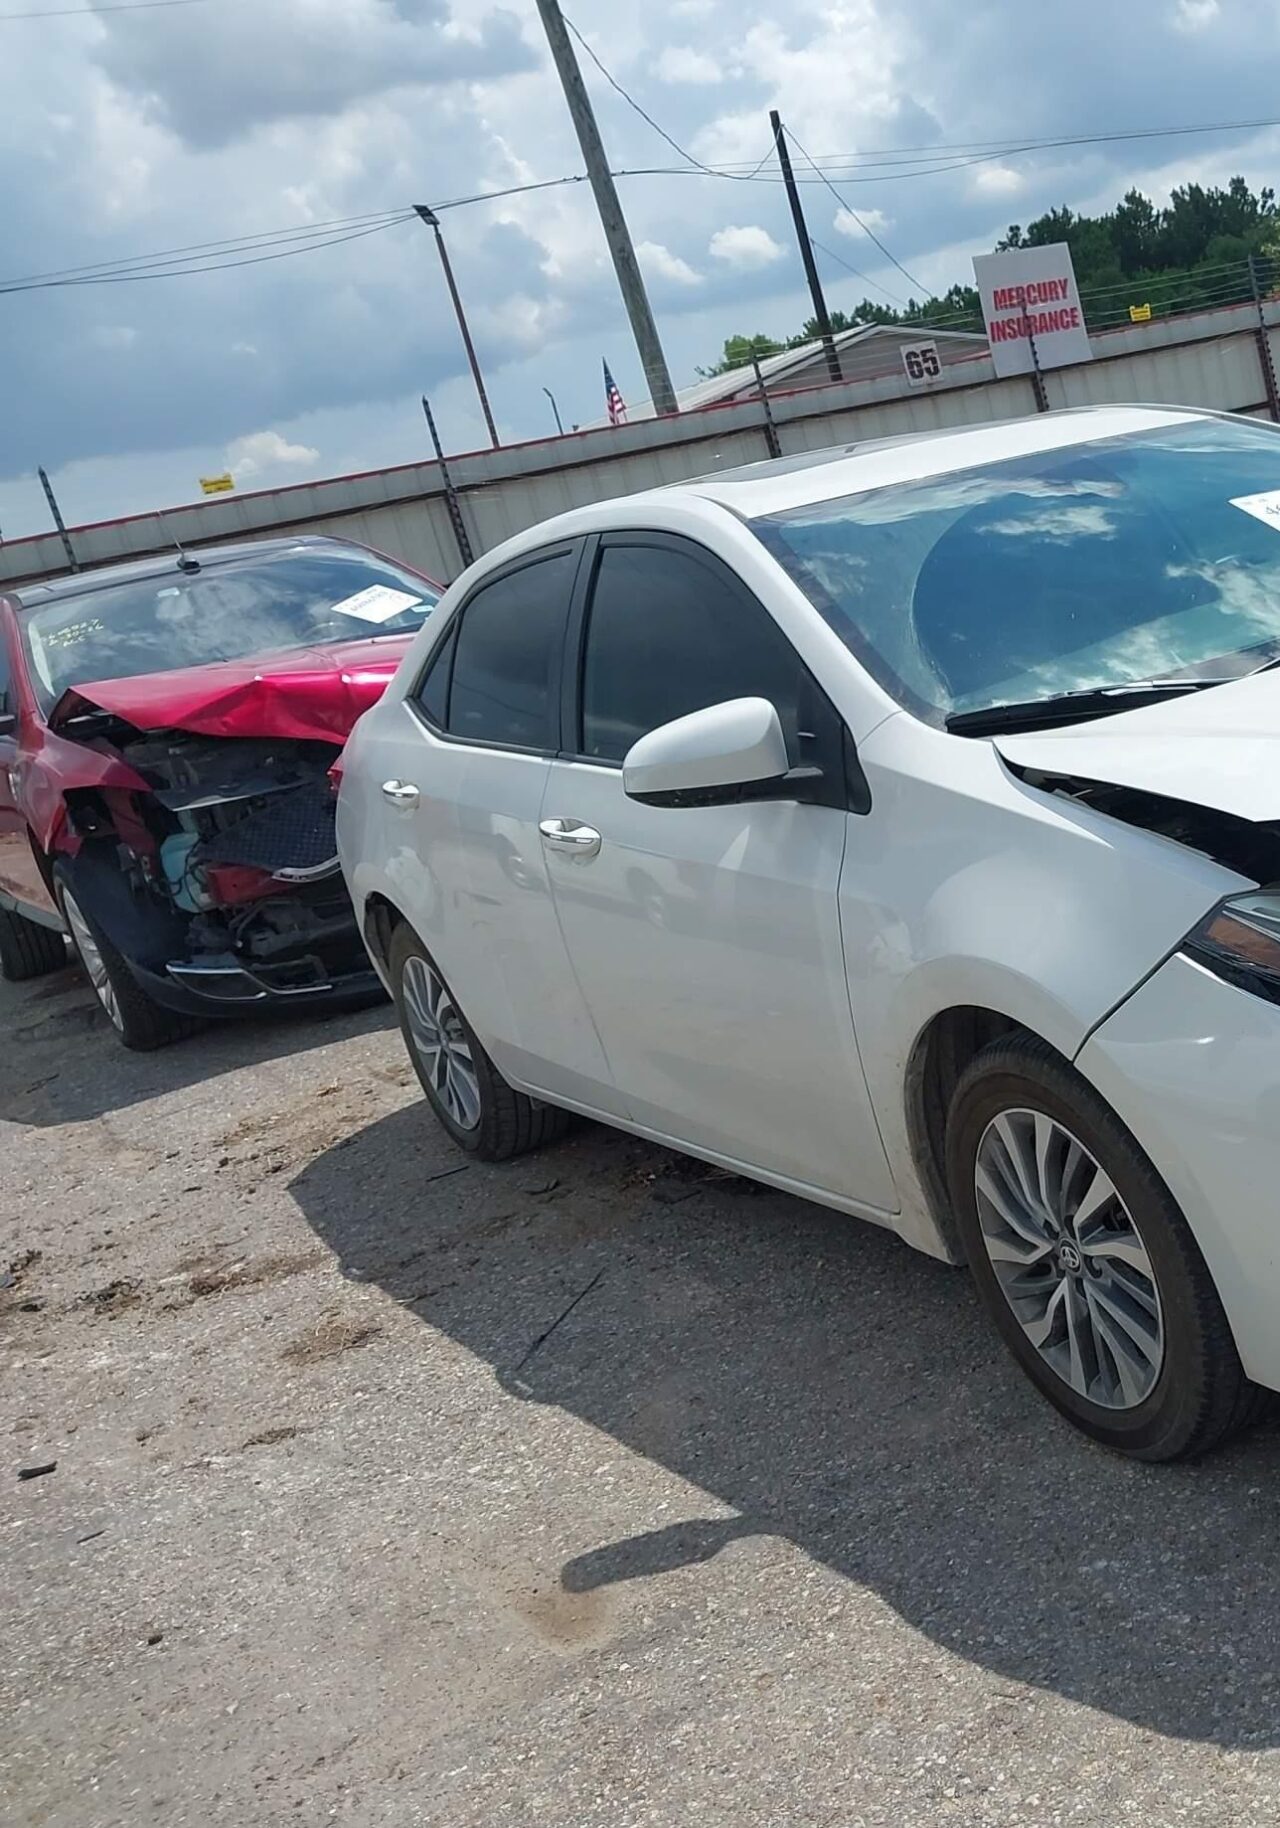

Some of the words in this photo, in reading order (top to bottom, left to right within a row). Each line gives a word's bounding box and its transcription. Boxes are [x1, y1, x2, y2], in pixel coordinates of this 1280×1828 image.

[993, 278, 1069, 312] MERCURY
[990, 306, 1080, 343] INSURANCE
[904, 347, 941, 380] 65
